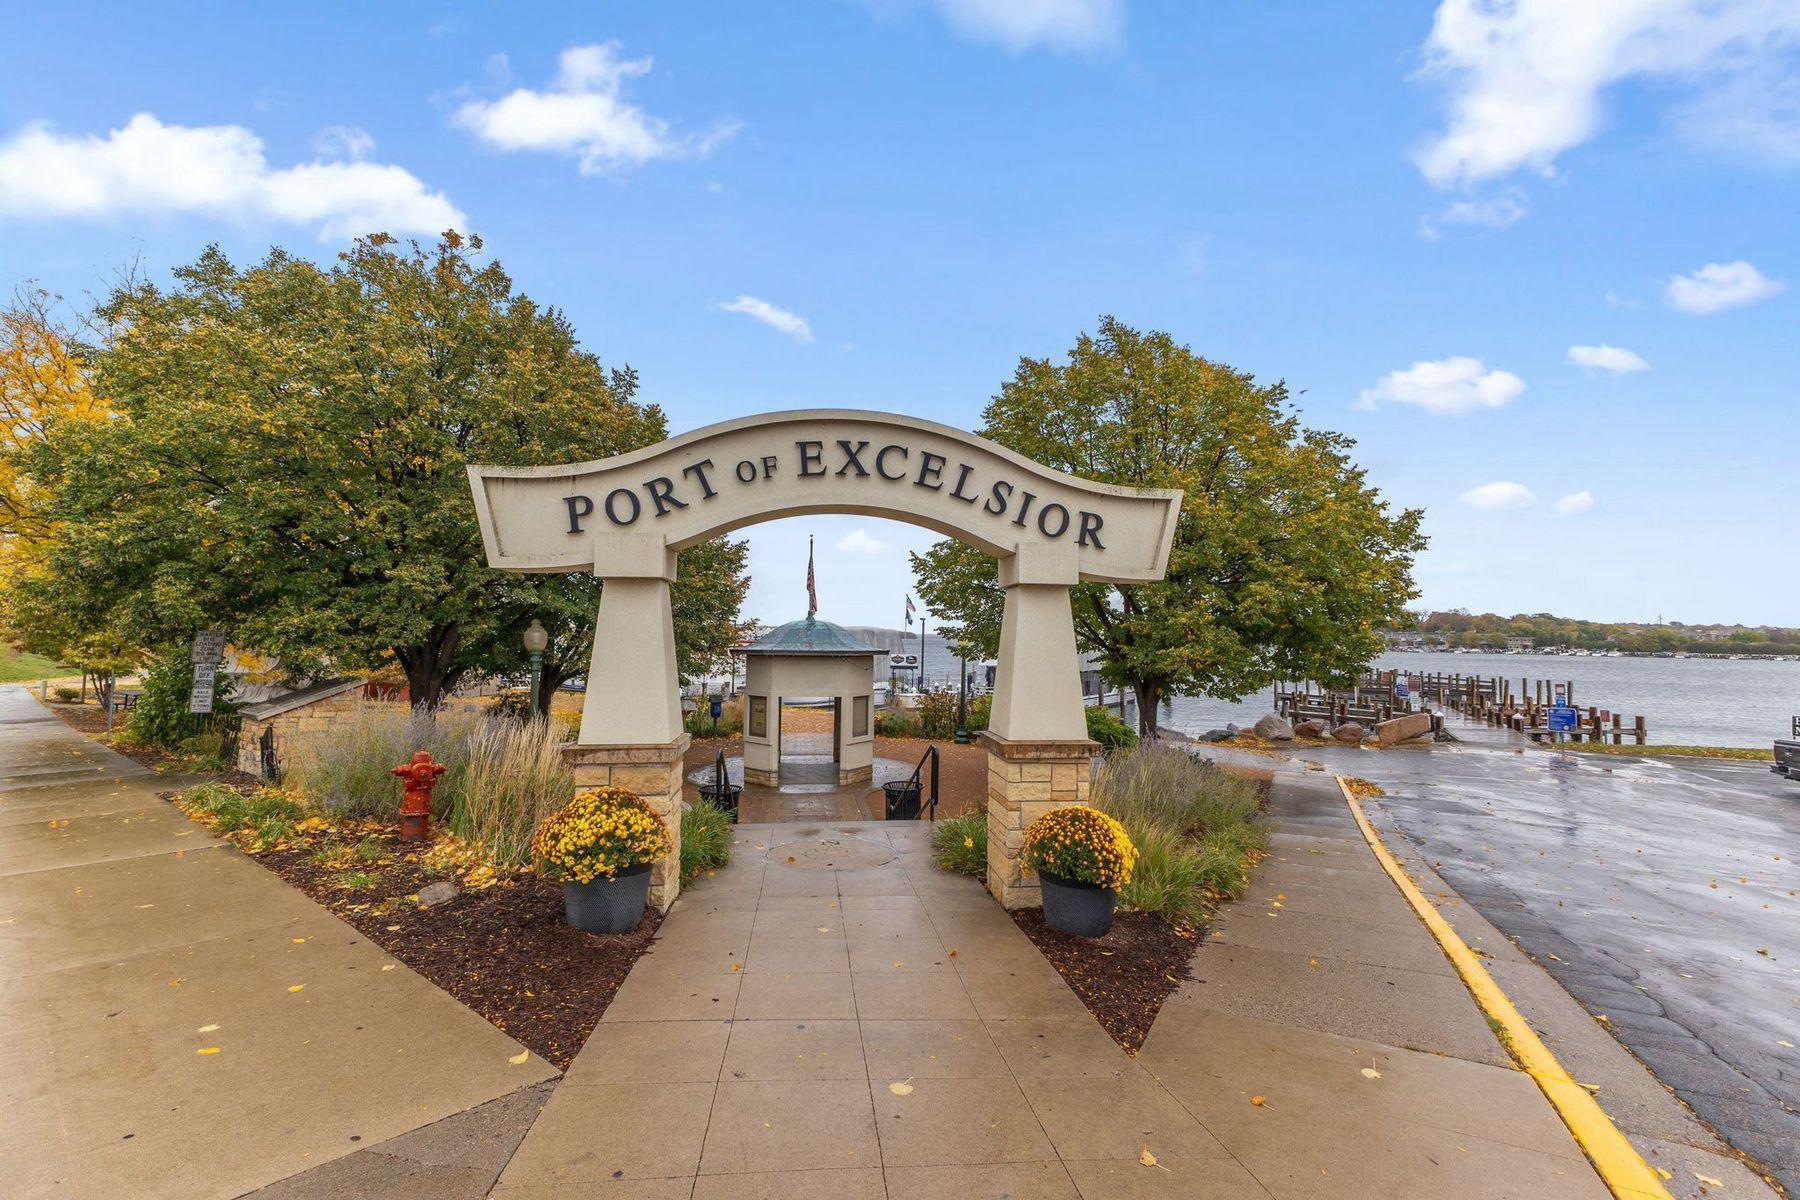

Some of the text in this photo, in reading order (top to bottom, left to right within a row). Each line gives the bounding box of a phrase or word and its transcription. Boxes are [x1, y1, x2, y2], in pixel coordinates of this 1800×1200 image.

[562, 440, 1106, 549] PORT OF EXCELSIOR
